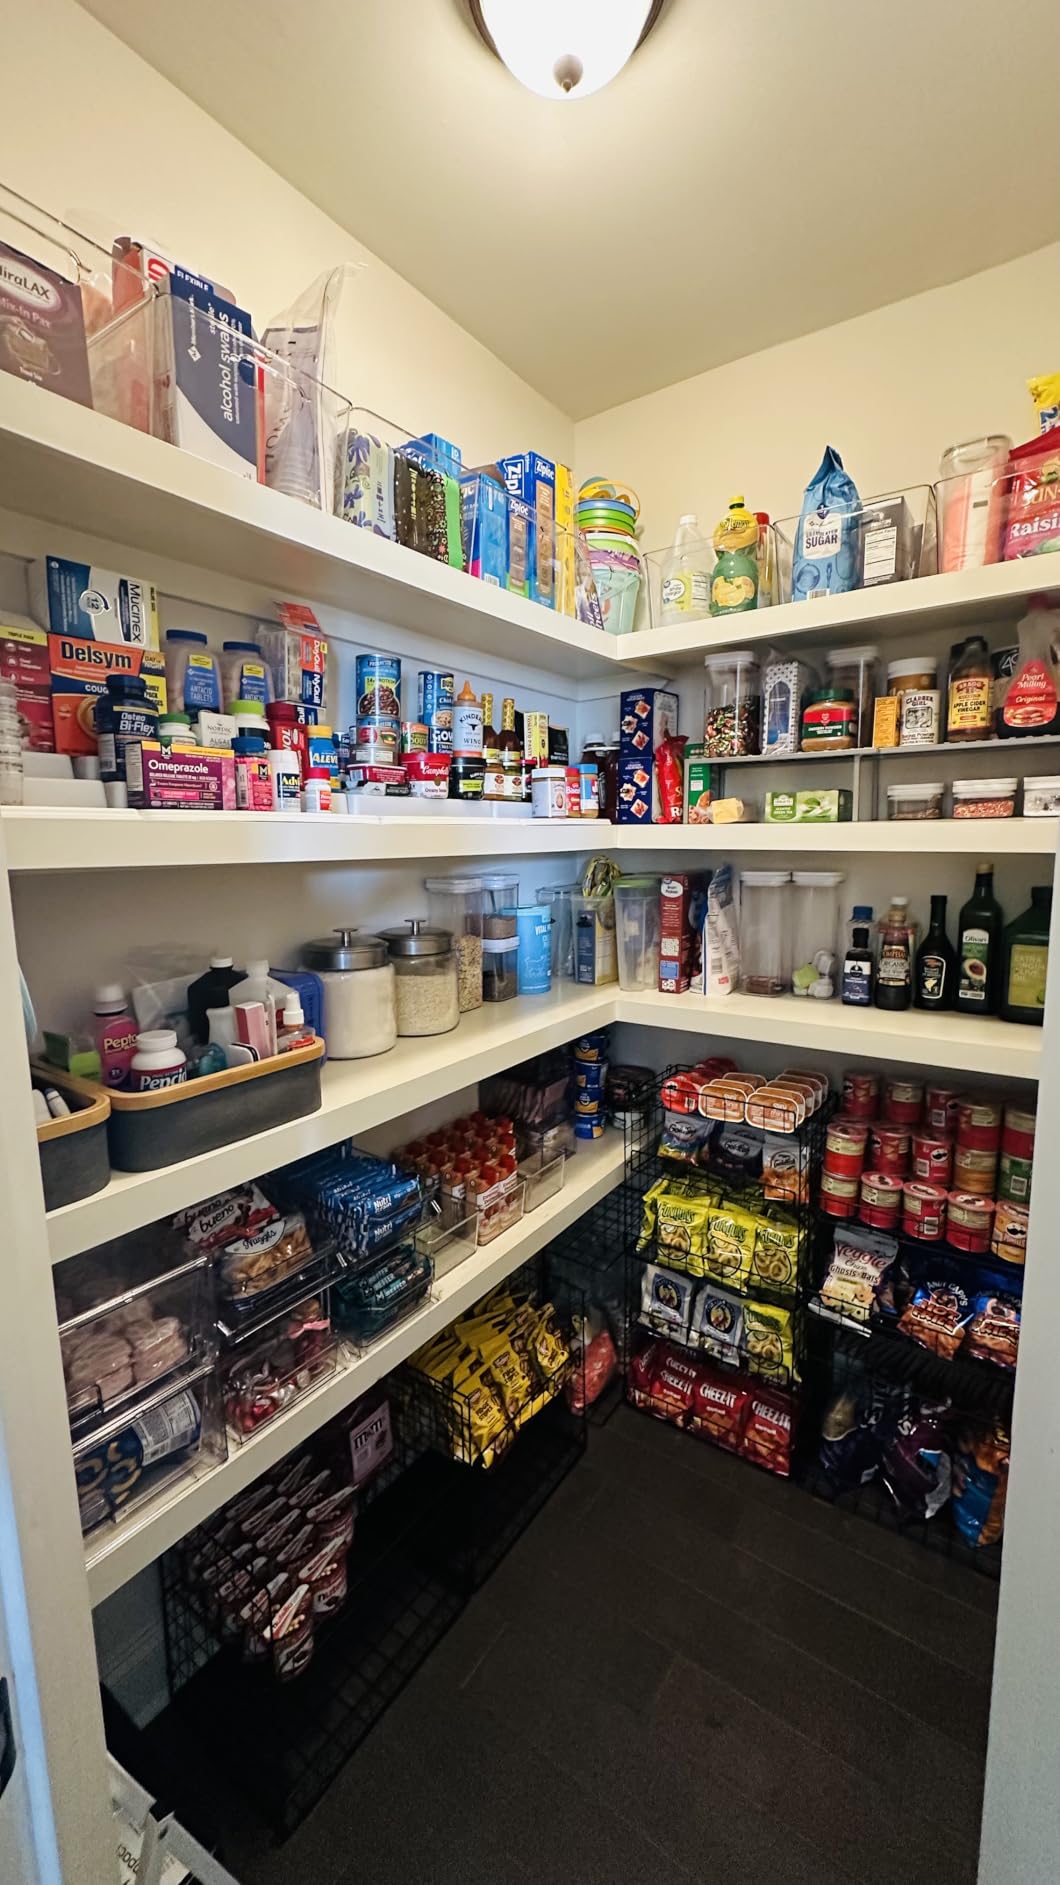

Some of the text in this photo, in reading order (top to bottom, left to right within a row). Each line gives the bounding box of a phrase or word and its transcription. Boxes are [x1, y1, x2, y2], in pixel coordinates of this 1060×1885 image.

[0, 264, 51, 301] iraLAX
[218, 364, 233, 422] alcohol
[535, 459, 555, 481] Ziploc
[505, 462, 523, 495] Zipl
[510, 499, 529, 516] Ziploc
[1010, 513, 1060, 540] Raisi
[805, 534, 839, 549] SUGAR
[61, 641, 132, 669] Delsym
[1017, 679, 1047, 689] Milling
[1021, 673, 1045, 682] Pearl
[84, 684, 110, 695] COUG
[312, 673, 321, 704] NyQuil
[953, 700, 987, 709] APPLE CIDER
[1015, 694, 1046, 703] Original
[121, 712, 145, 722] Osteo
[459, 712, 484, 723] KINDER
[119, 720, 155, 736] Bi-Flex
[312, 752, 338, 764] ALEV
[148, 759, 209, 774] Omeprazole
[422, 765, 449, 776] Campbel
[282, 774, 301, 786] Advi
[103, 1033, 138, 1050] Pepto
[373, 1193, 392, 1209] Nutri
[199, 1204, 235, 1233] bueno
[836, 1241, 888, 1270] Veggie
[861, 1272, 880, 1286] Bats
[921, 1297, 957, 1321] HOT
[700, 1383, 737, 1409] CHEEZ-IT
